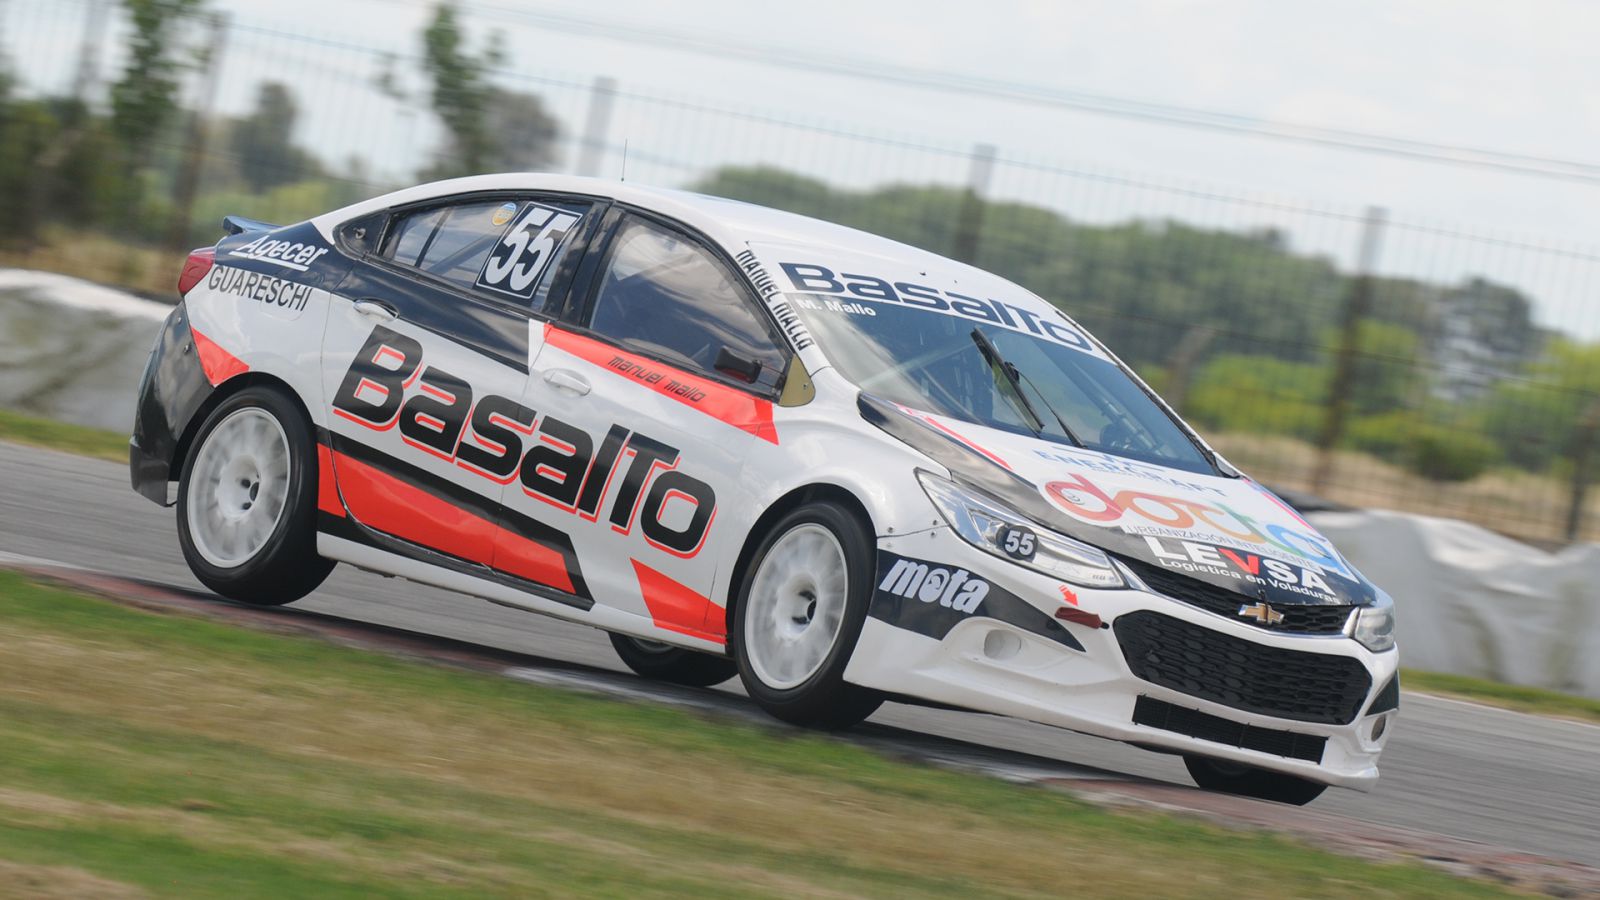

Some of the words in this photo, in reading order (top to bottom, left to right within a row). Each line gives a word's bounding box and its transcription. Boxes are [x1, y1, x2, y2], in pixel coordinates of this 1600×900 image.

[234, 234, 329, 266] Agecer
[486, 206, 578, 291] 55
[208, 264, 313, 311] GUARESCHI
[795, 298, 822, 311] M.
[823, 299, 877, 317] Mallo
[1004, 529, 1036, 556] 55
[1143, 535, 1337, 596] LEVSA
[878, 558, 990, 614] mota
[1245, 574, 1267, 586] en
[1267, 578, 1342, 604] Voladuras
